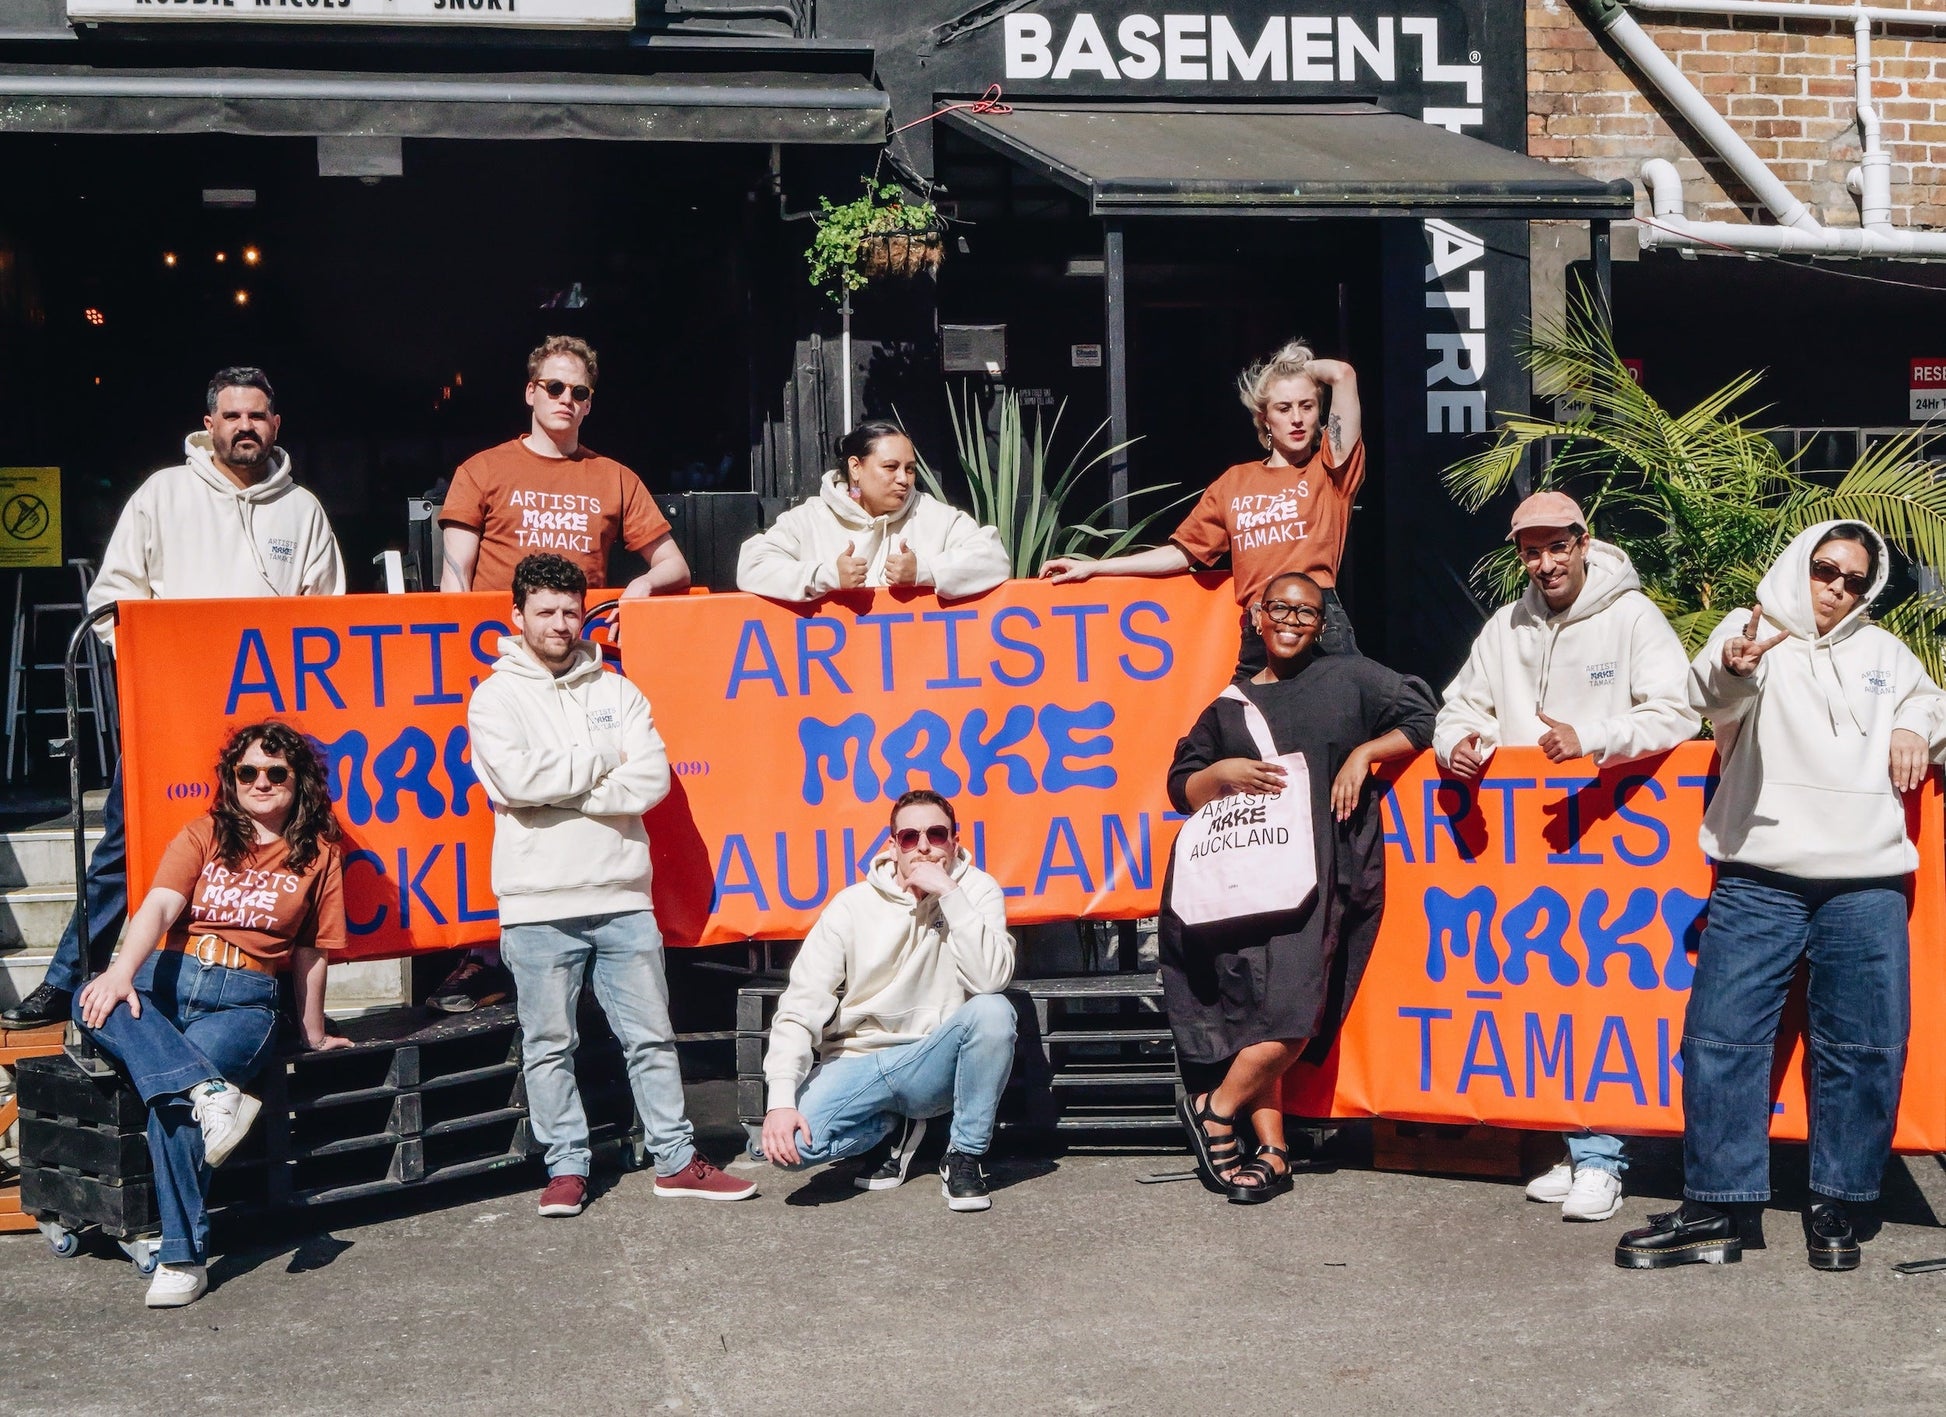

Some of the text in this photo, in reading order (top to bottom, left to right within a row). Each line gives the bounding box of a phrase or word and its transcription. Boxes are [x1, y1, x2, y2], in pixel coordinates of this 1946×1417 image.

[1003, 13, 1438, 82] BASEMENT
[1422, 66, 1487, 433] TATRE
[1916, 398, 1939, 410] 24Hr
[509, 490, 601, 514] ARTISTS
[1236, 499, 1299, 531] MAKE
[522, 508, 589, 532] MAKE
[1233, 520, 1308, 552] TĀMAKI
[515, 527, 593, 553] TĀMAKI
[726, 602, 1174, 699] ARTISTS
[798, 701, 1118, 806] MAKE
[167, 782, 210, 801] (09)
[1208, 805, 1267, 836] MAKE
[1190, 827, 1289, 861] AUCKLAND
[201, 861, 300, 893] ARTISTS
[201, 884, 279, 912] MAKE
